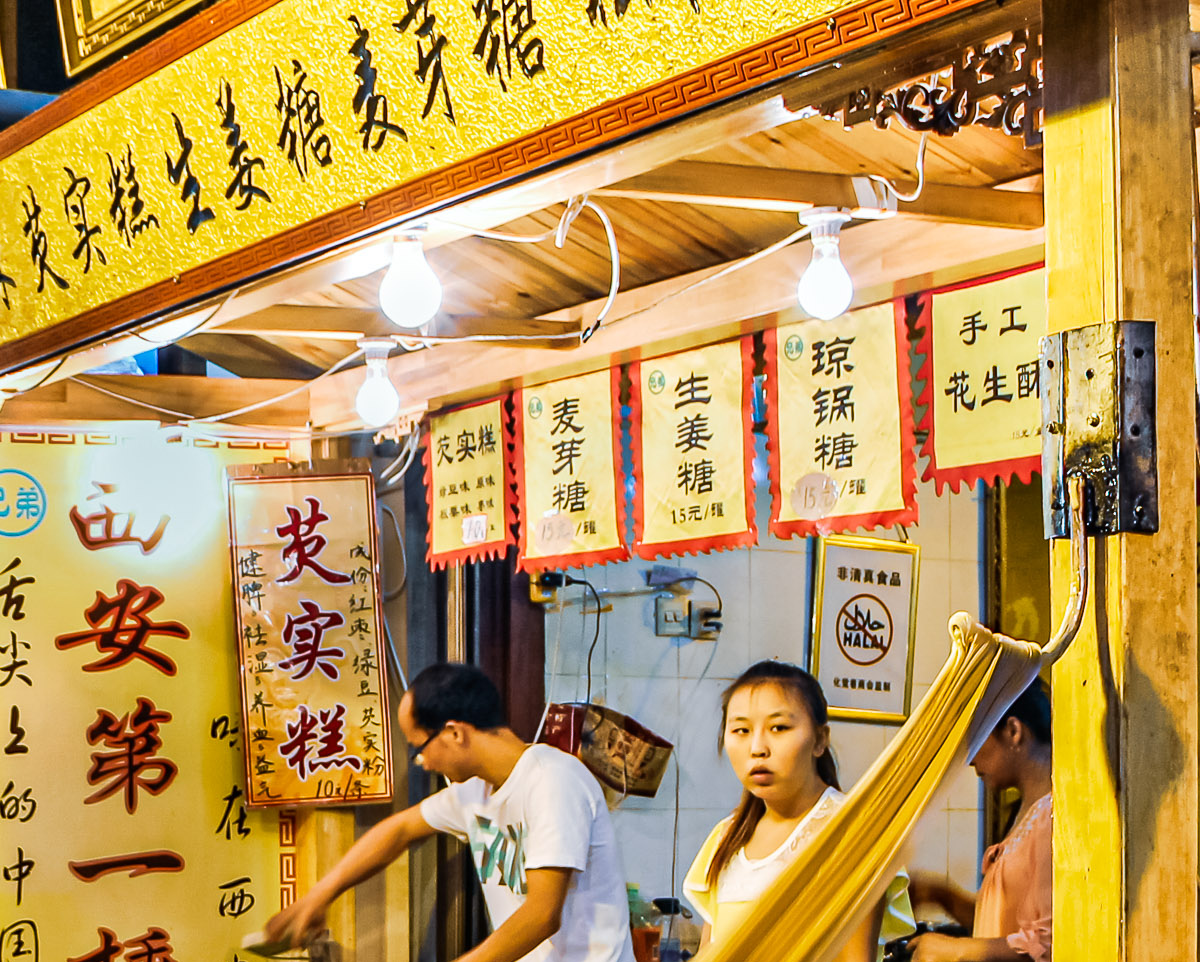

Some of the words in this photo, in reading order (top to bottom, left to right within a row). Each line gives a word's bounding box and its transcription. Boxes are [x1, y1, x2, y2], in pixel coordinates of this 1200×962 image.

[21, 143, 159, 293] 芡实糕
[959, 305, 1028, 346] 手工
[811, 336, 858, 471] 琼锅糖
[945, 359, 1041, 415] 花生酥
[436, 424, 497, 468] 芡实糕
[551, 398, 590, 514] 麦芽糖
[675, 371, 716, 496] 生姜糖
[837, 566, 902, 587] 非清真食品
[275, 496, 363, 780] 芡实糕
[843, 632, 887, 650] HALAL
